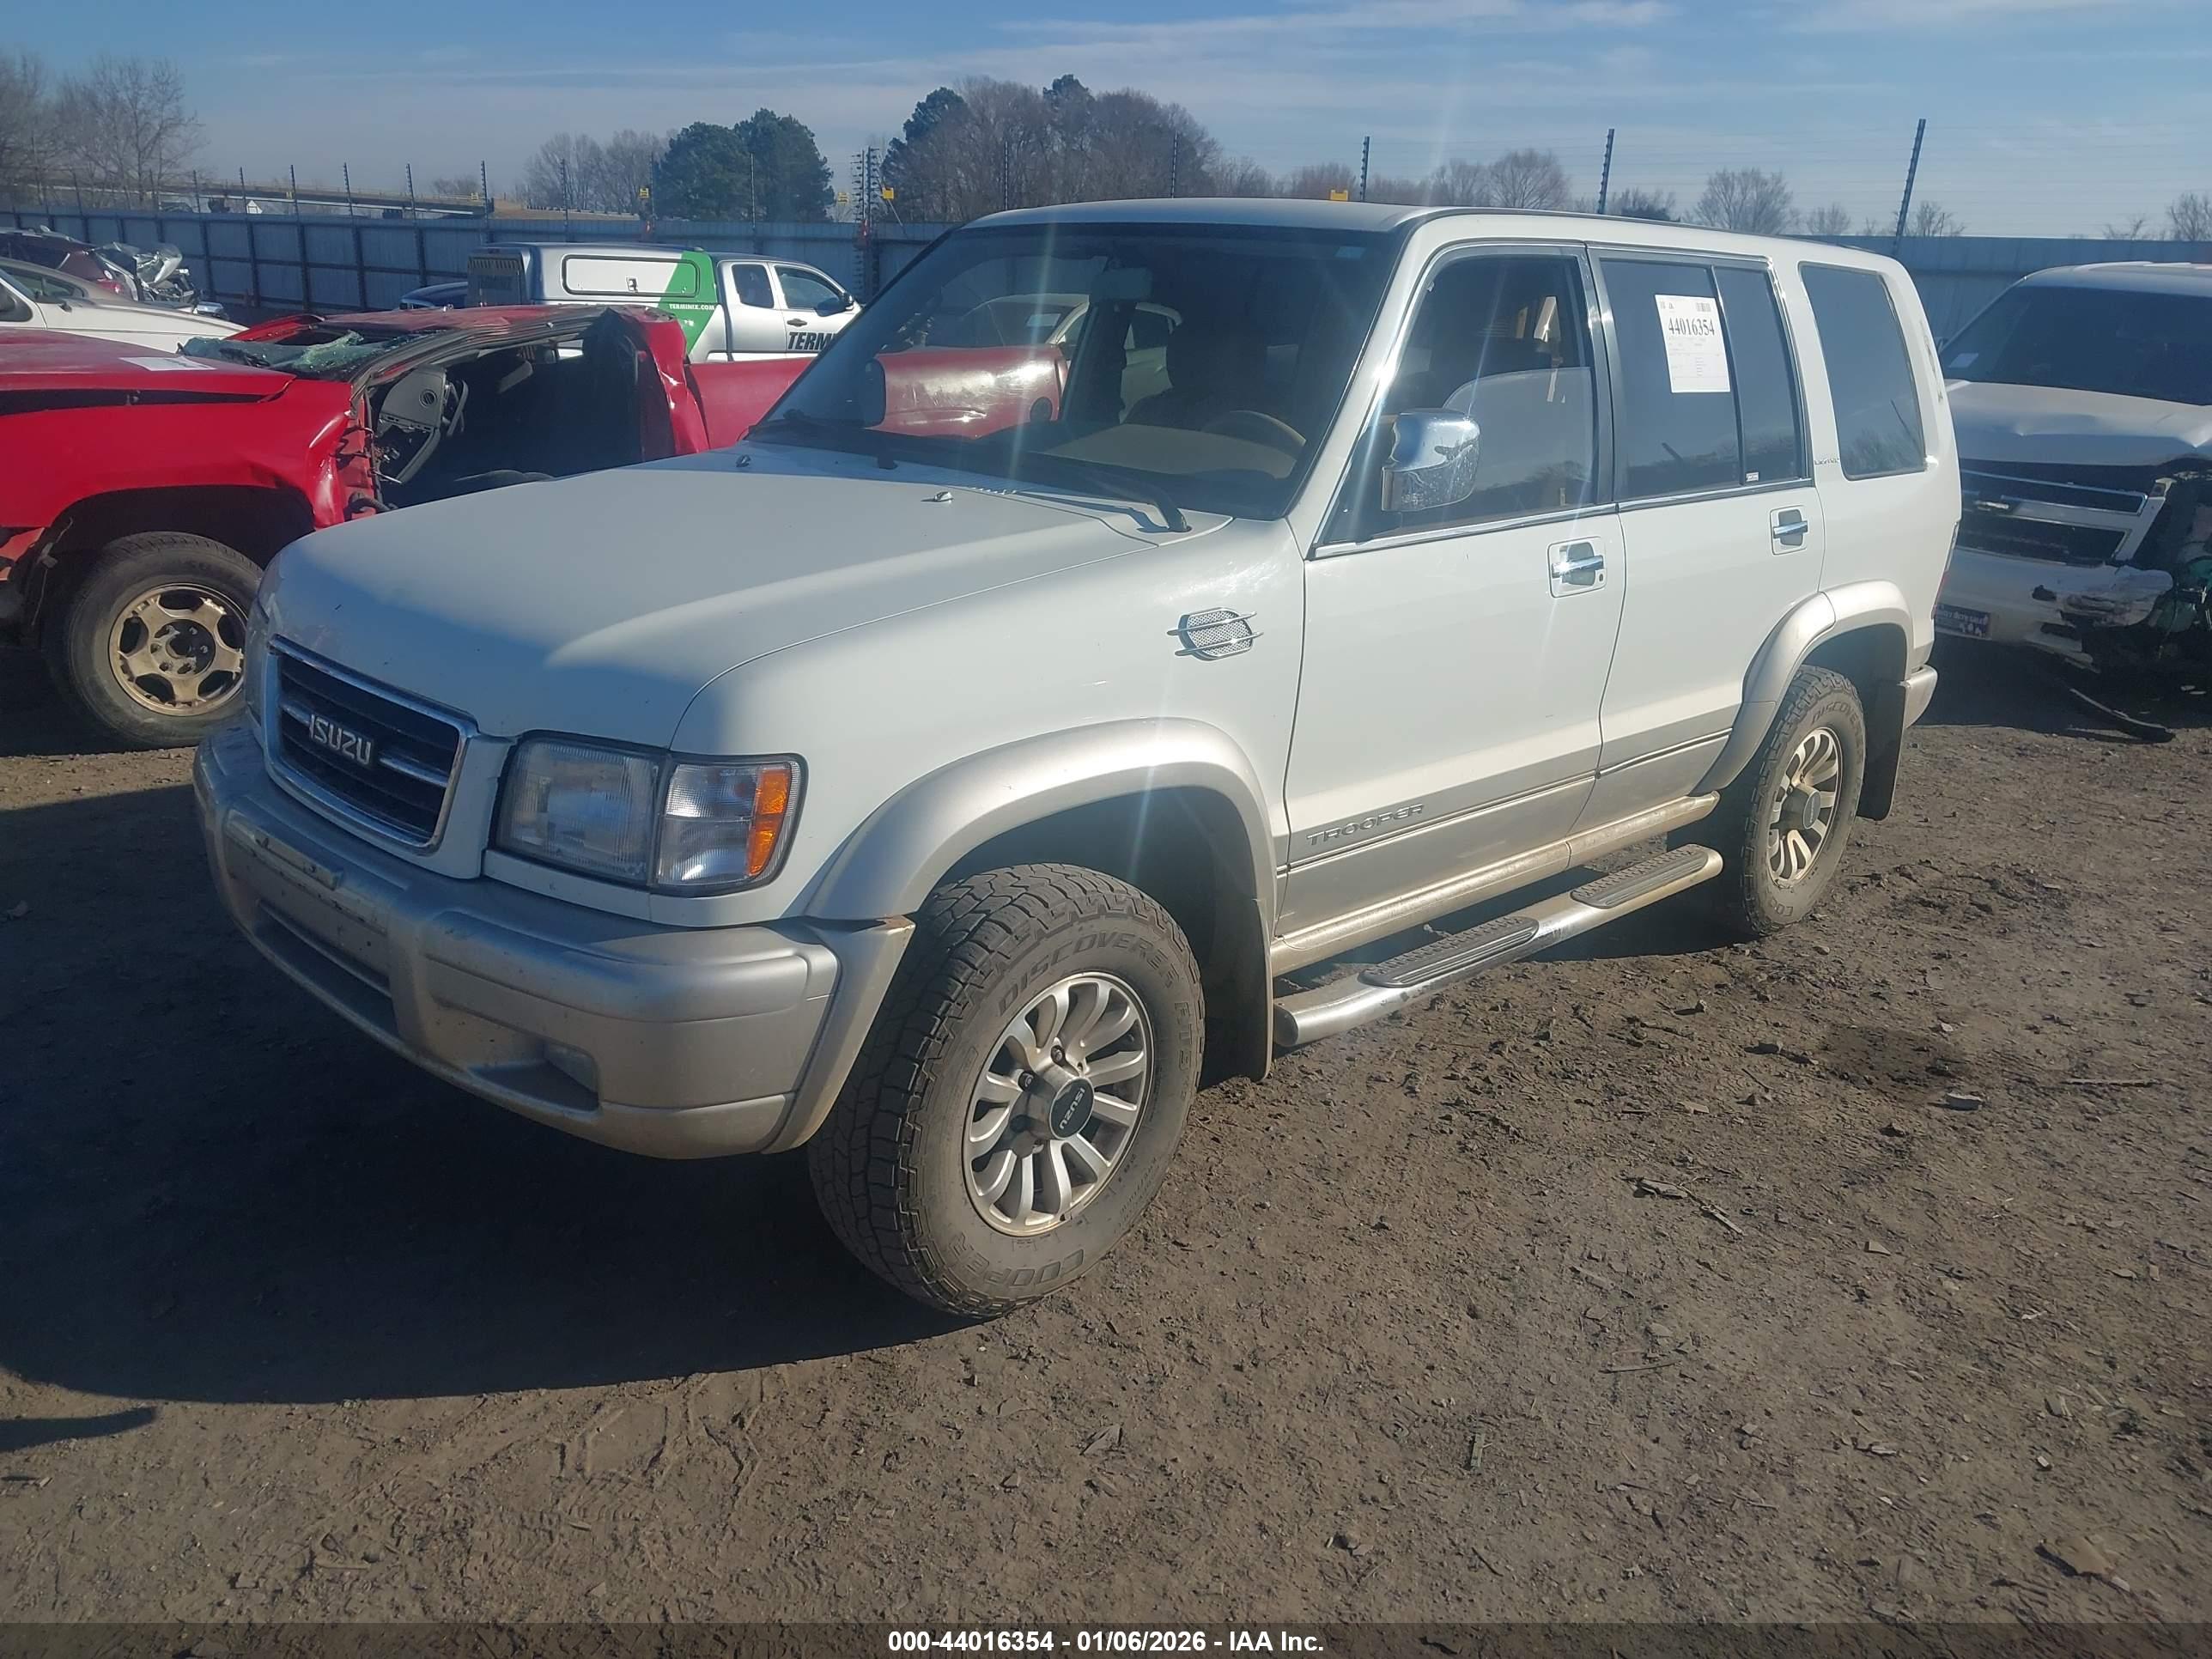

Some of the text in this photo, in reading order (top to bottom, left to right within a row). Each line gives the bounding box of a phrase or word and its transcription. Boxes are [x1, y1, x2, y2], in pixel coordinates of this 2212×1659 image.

[787, 331, 838, 350] TERM
[1668, 316, 1716, 337] 44016354
[309, 714, 372, 765] ISUZU
[1305, 803, 1425, 846] TROOPER
[998, 930, 1180, 1018] DISCOVERER
[1059, 1087, 1085, 1129] ISUZU
[948, 1231, 1085, 1288] COOPER
